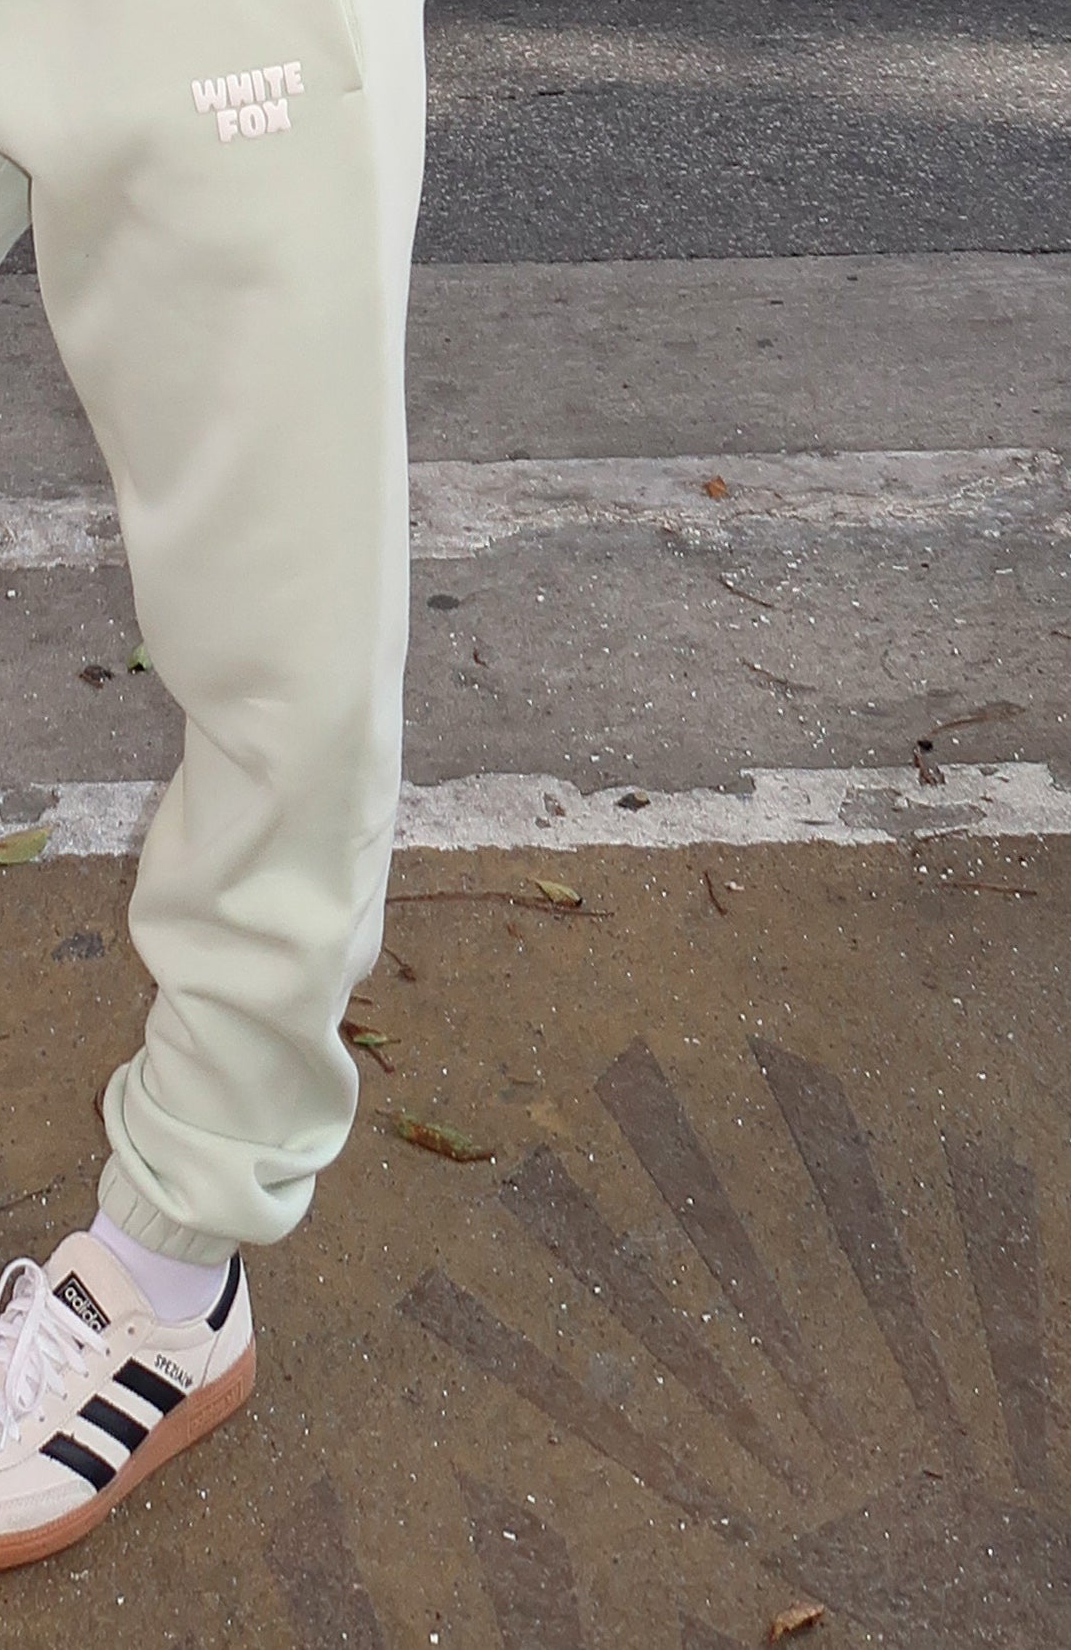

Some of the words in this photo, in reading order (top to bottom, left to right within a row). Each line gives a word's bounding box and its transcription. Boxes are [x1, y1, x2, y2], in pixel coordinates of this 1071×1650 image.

[190, 60, 305, 114] WHITE
[216, 97, 292, 143] FOX
[64, 1286, 102, 1334] adida
